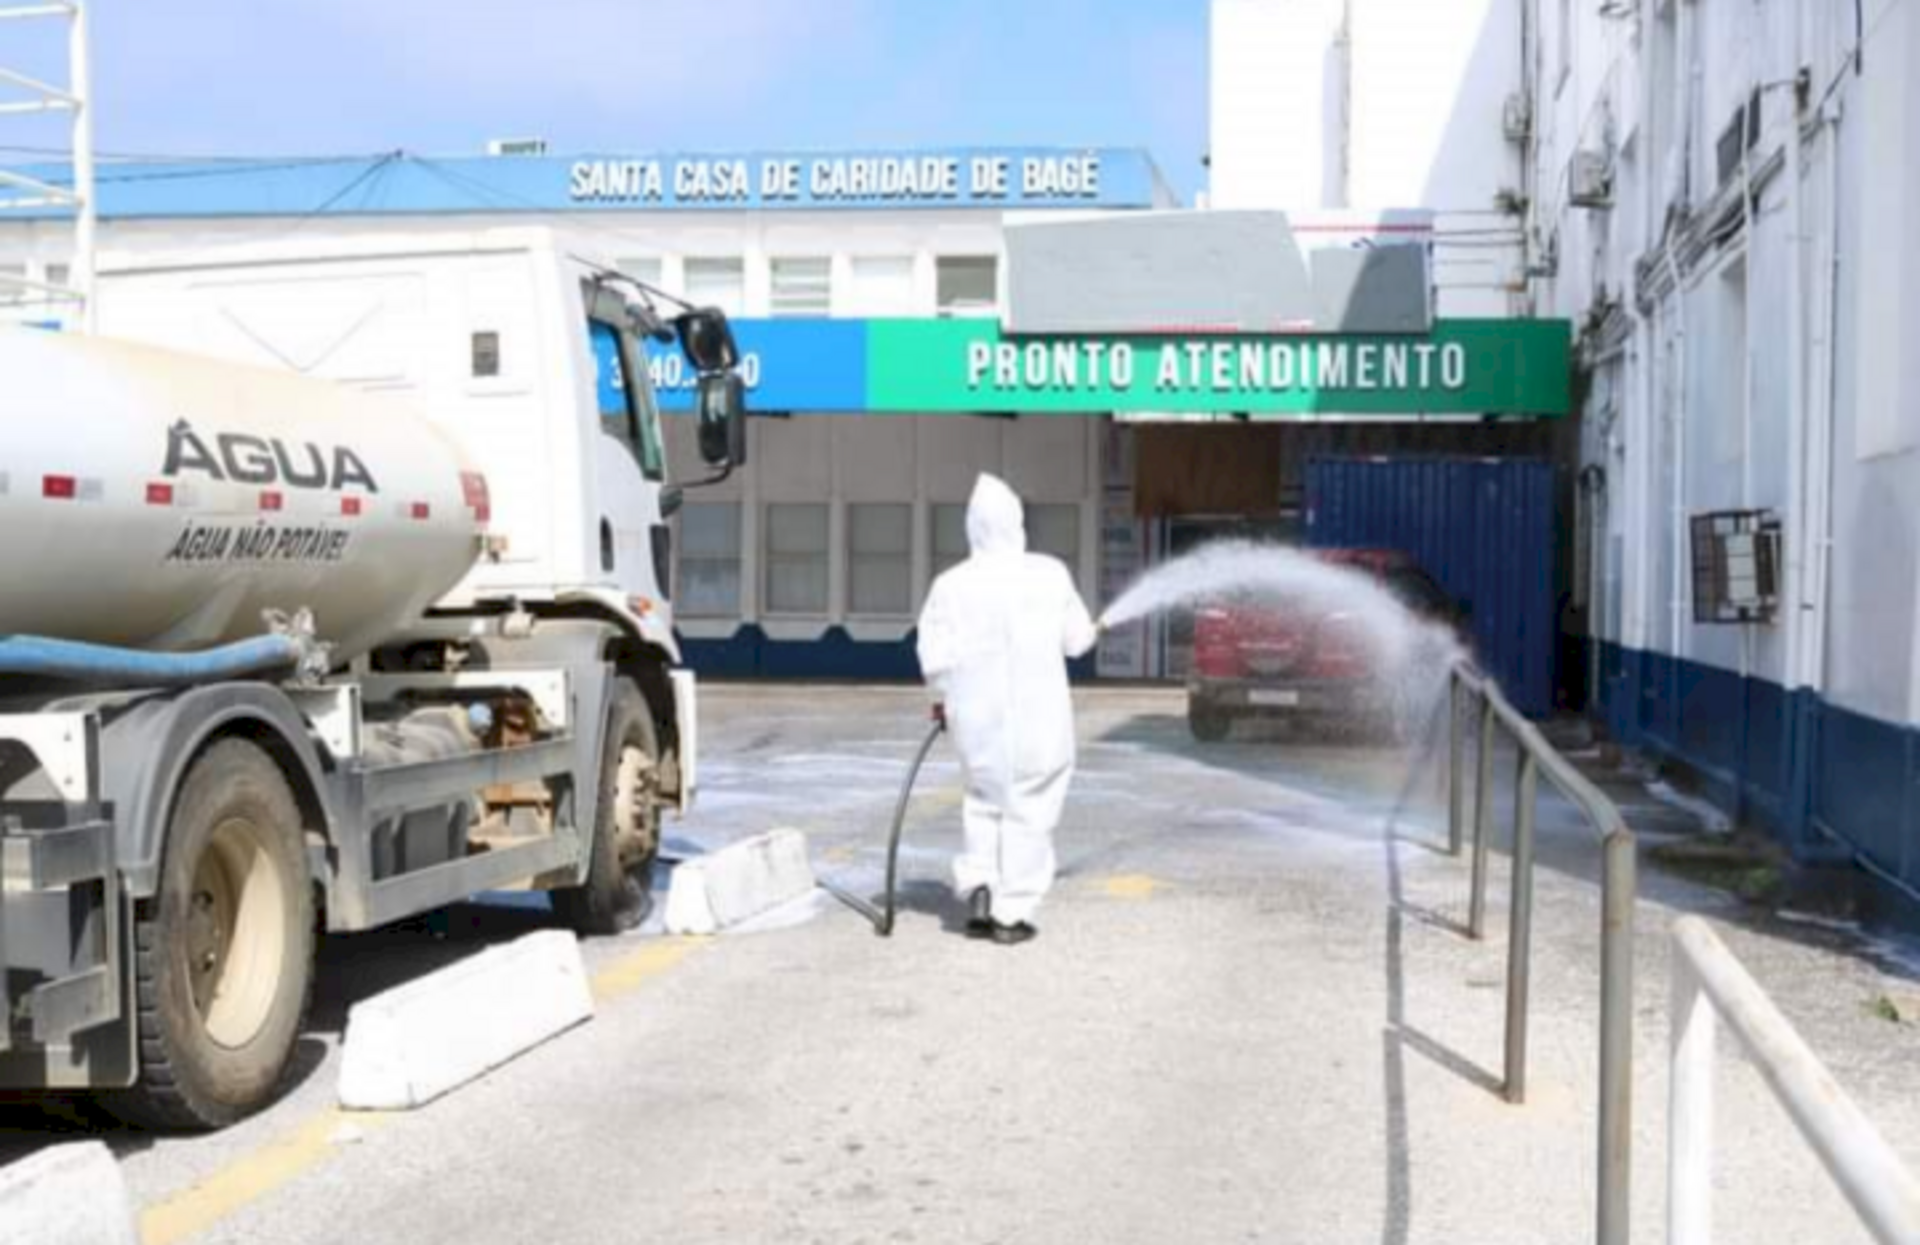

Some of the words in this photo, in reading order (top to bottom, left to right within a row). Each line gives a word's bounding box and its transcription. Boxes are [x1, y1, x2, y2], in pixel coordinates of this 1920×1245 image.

[571, 160, 662, 201] SANTA
[674, 159, 748, 201] CASA
[761, 158, 800, 200] DE
[810, 157, 958, 200] CARIDADE
[970, 156, 1008, 199] DE
[1022, 149, 1098, 199] BAGÉ
[967, 341, 1133, 392] PRONTO
[1156, 341, 1467, 393] ATENDIMENTO
[162, 417, 378, 493] ÁGUA
[166, 519, 231, 560] ÁGUA
[231, 519, 276, 559] NÃO
